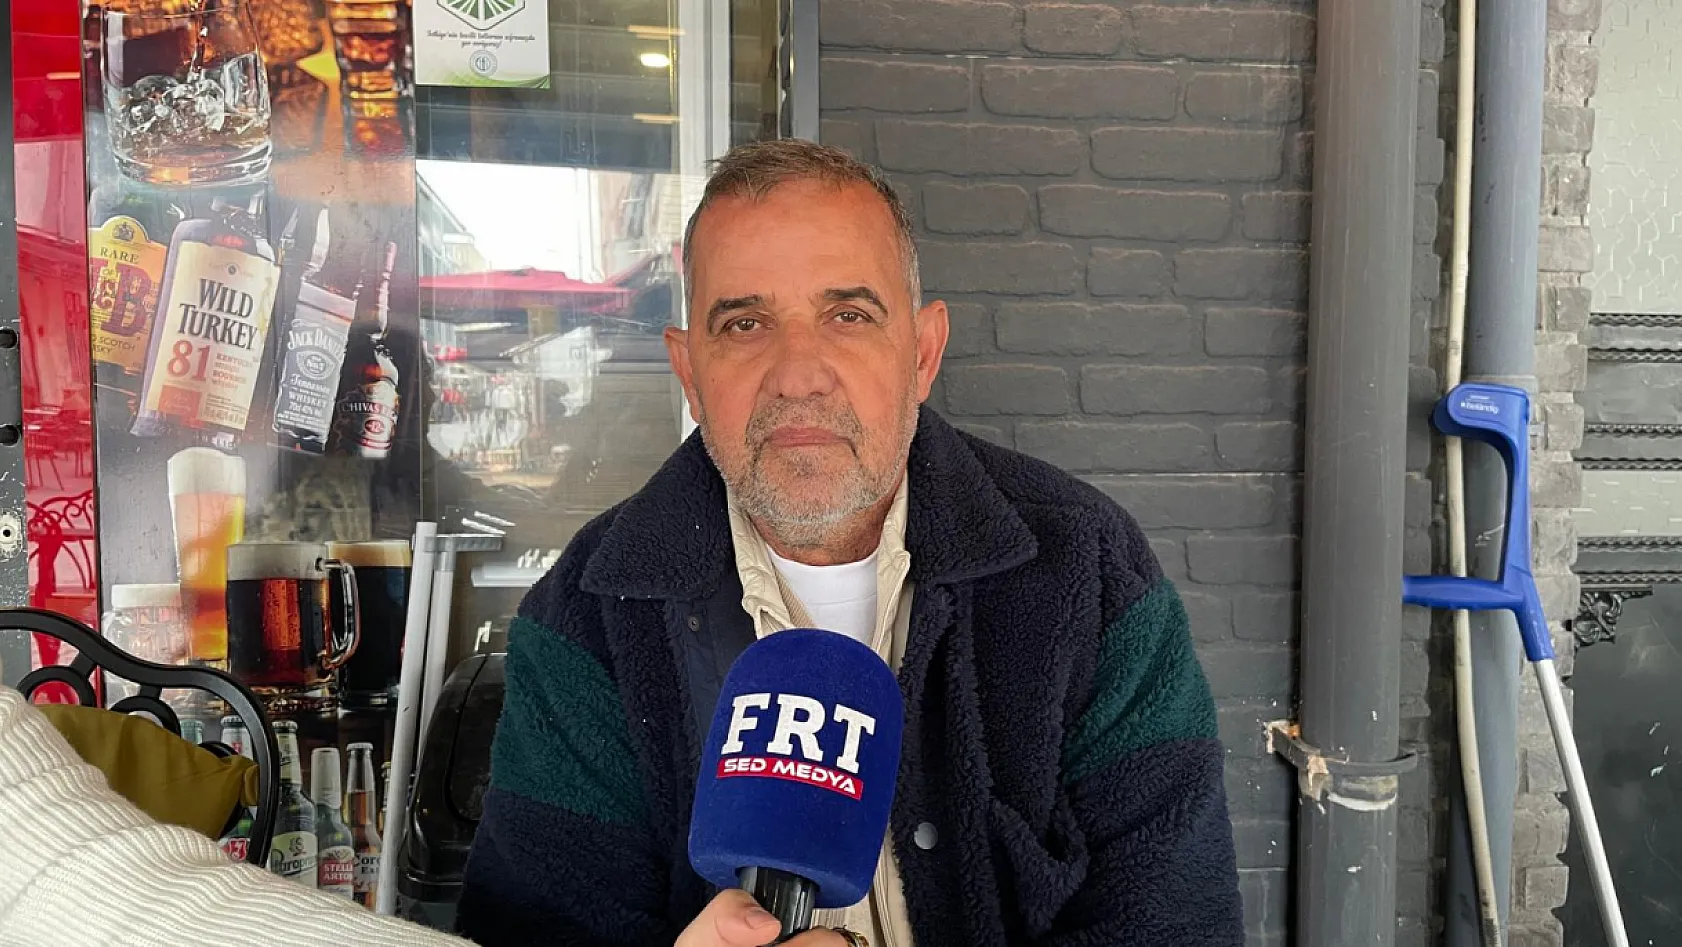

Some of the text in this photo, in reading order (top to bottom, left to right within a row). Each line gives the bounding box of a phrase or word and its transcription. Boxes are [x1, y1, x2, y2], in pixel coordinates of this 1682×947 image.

[99, 246, 140, 264] RARE
[198, 278, 254, 319] WILD
[98, 336, 136, 353] SCOTCH
[177, 303, 259, 352] TURKEY
[288, 331, 313, 349] JACK
[167, 339, 211, 382] 81
[342, 402, 380, 414] CHIVAS
[721, 693, 877, 774] FRT
[723, 757, 856, 795] SED MEDYA
